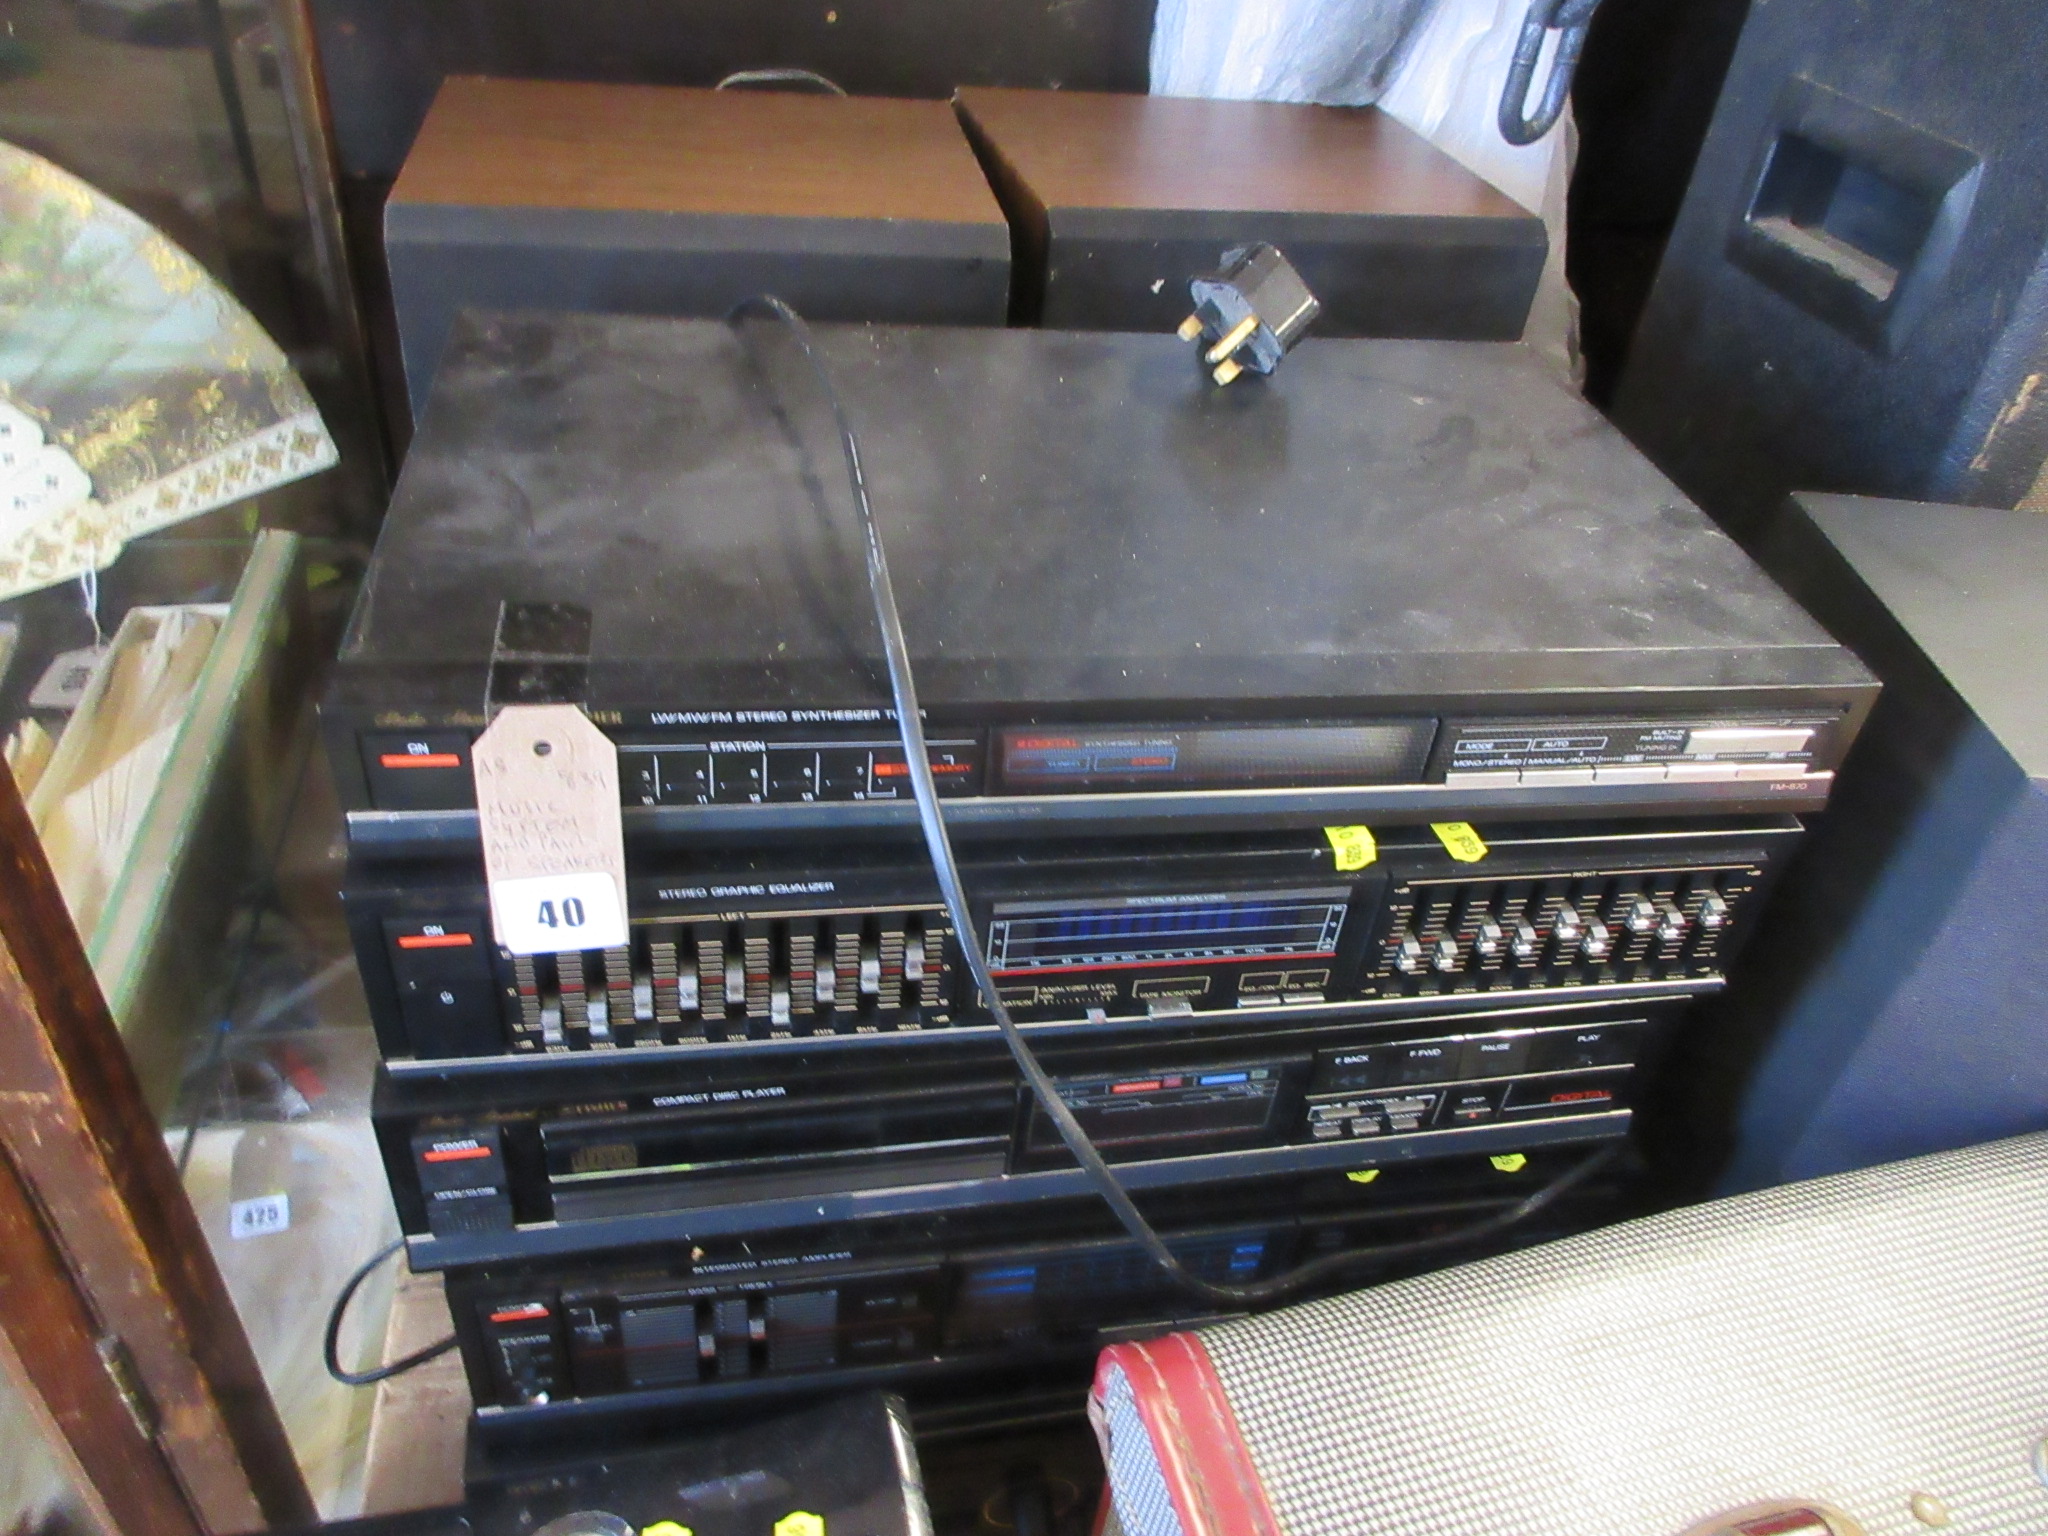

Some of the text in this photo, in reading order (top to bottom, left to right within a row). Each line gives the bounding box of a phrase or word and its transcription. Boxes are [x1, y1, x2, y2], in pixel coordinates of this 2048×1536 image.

[736, 710, 789, 723] STEREO
[709, 740, 766, 754] STATION
[1465, 741, 1494, 753] MODE
[1542, 740, 1570, 752] AUTO
[658, 881, 836, 900] STEREO GRAPHIC EQUALIZER
[537, 897, 586, 928] 40
[1577, 1034, 1602, 1043] PLAY
[1418, 1048, 1442, 1058] FWD
[1481, 1043, 1511, 1052] PAUSE
[1343, 1054, 1370, 1064] BACK
[652, 1086, 787, 1107] COMPACT DISC PLAYER
